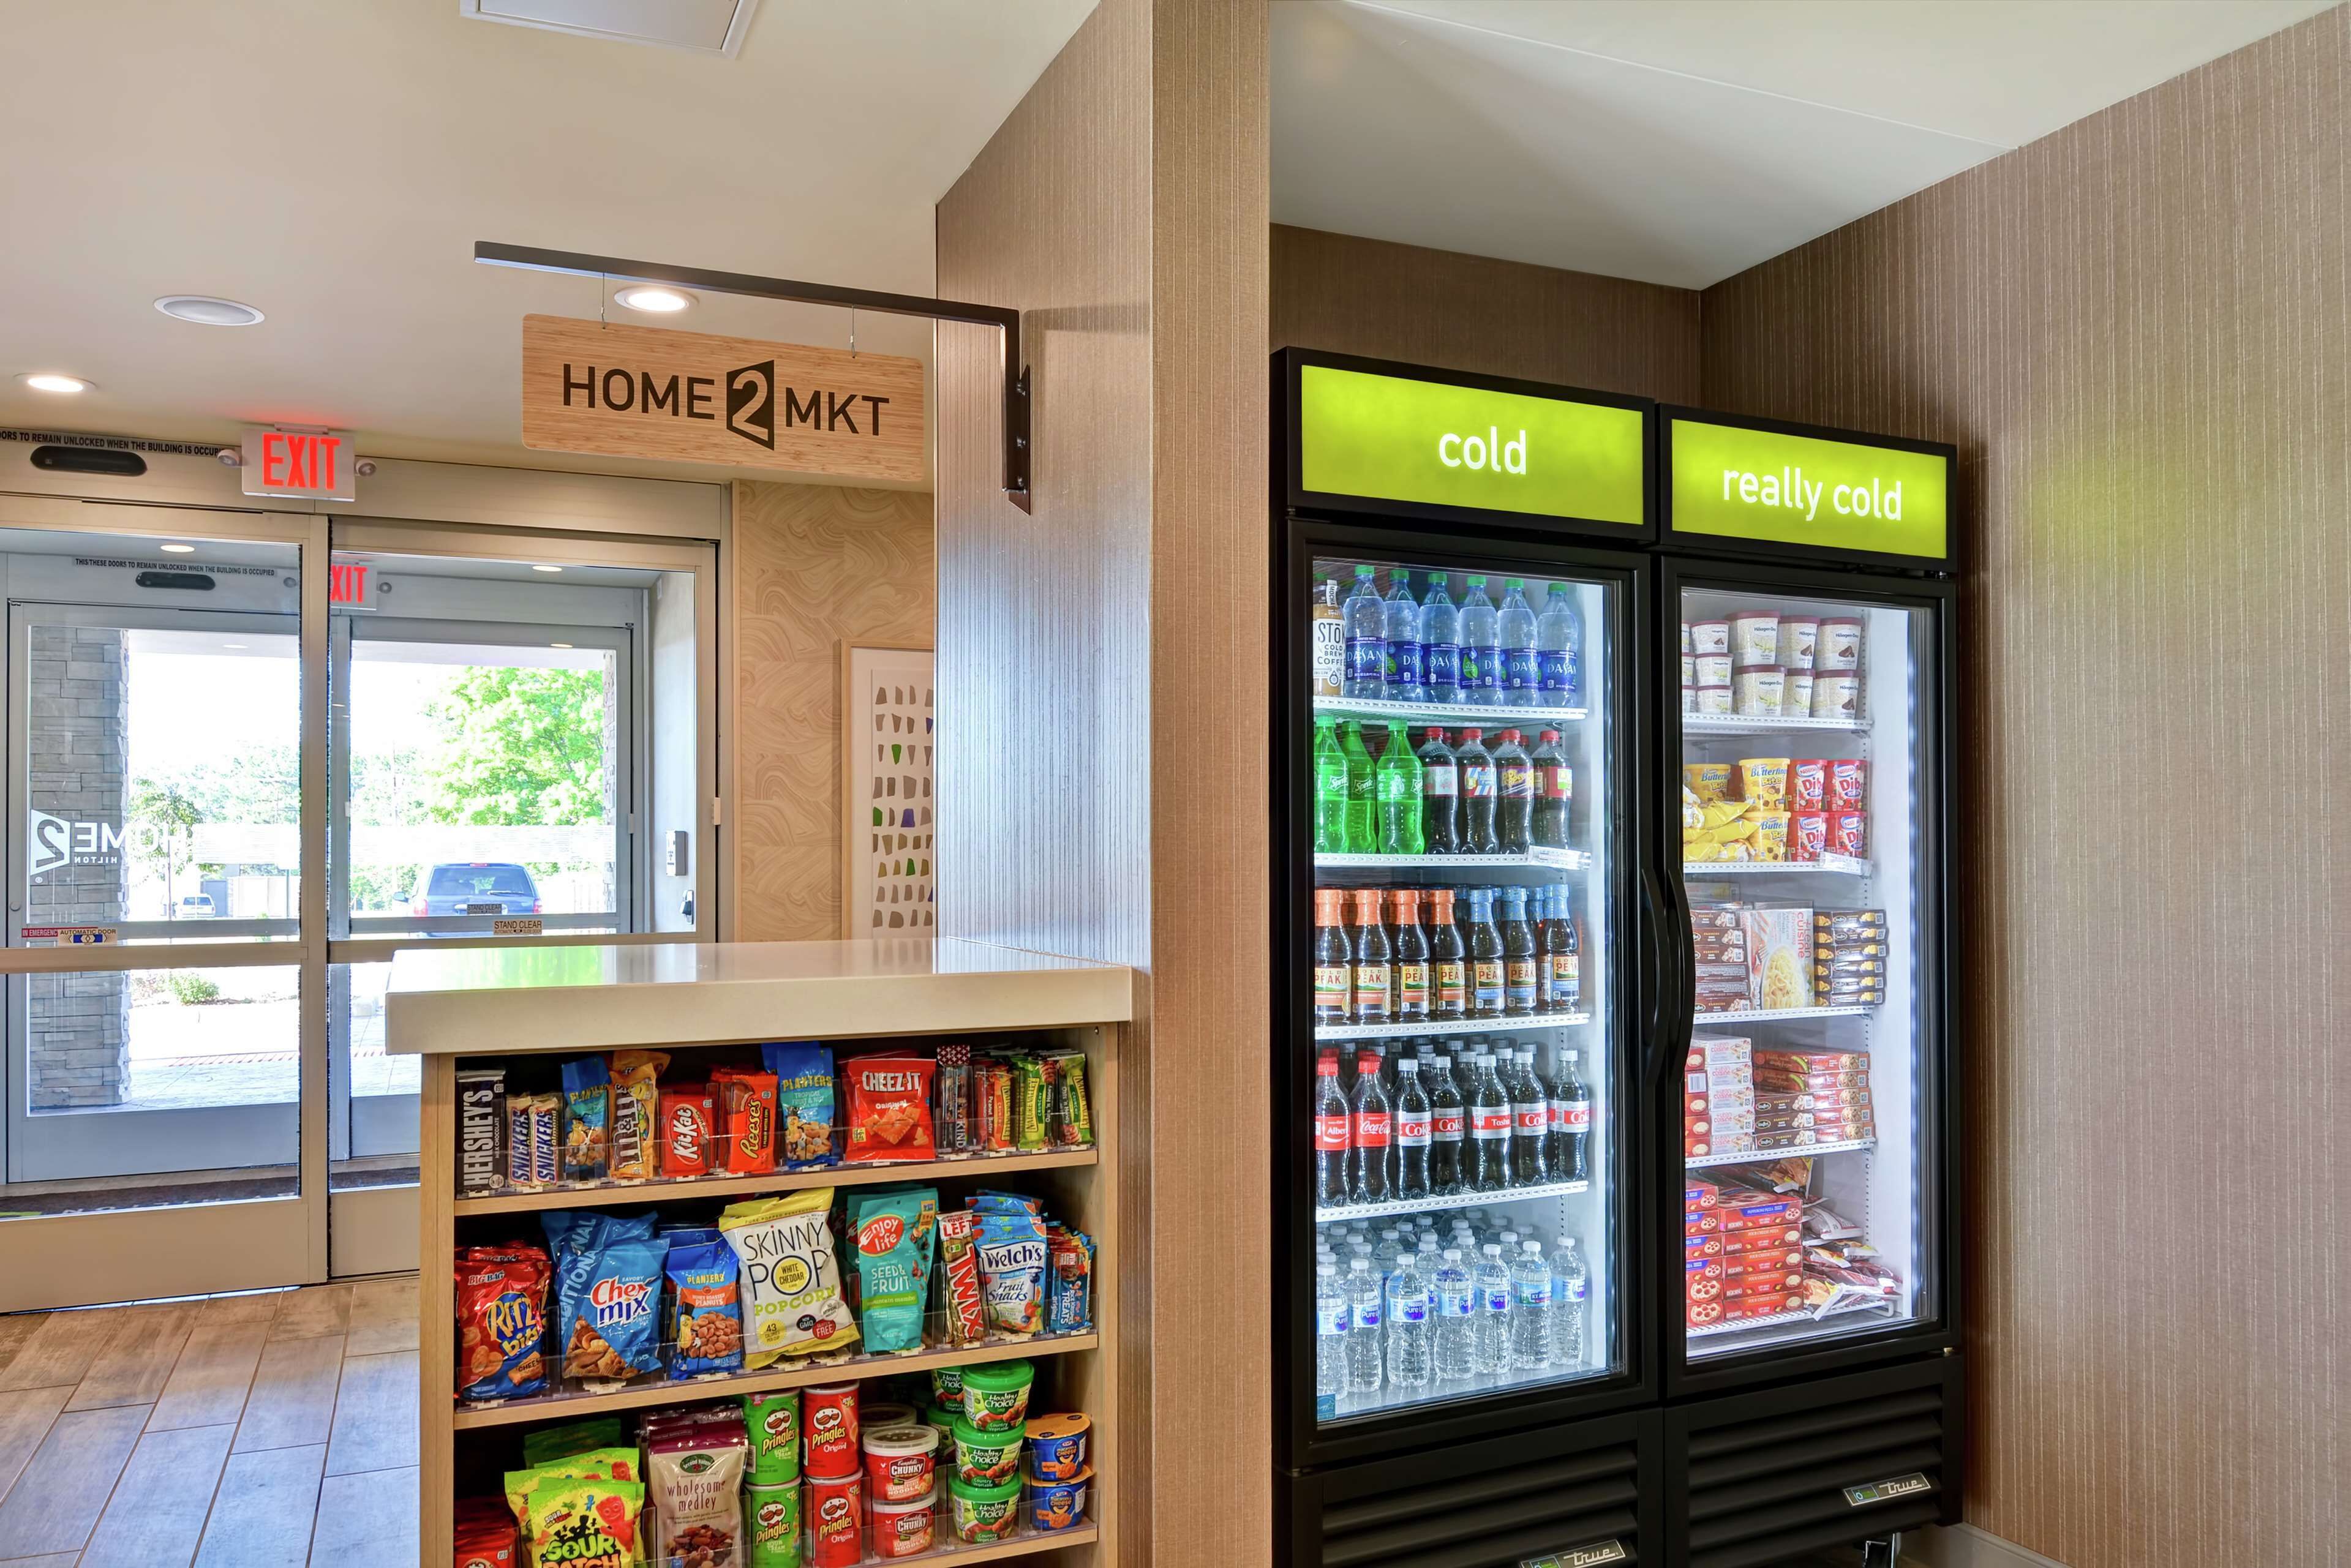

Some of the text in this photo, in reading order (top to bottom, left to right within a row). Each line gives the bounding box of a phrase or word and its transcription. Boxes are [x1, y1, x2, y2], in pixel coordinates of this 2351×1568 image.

[563, 363, 715, 420] HOME
[786, 387, 889, 436] MKT
[20, 432, 192, 454] TO REMAIN UNLOCKED WHEN THE BUILDING IS
[1438, 426, 1527, 476] cold
[262, 432, 341, 490] EXIT
[1722, 466, 1902, 522] really cold
[137, 561, 157, 570] REMAIN
[158, 562, 187, 571] UNLOCKED
[494, 920, 542, 929] STAND CLEAR
[783, 1075, 832, 1092] PLANTERS
[463, 1090, 494, 1187] HERSHEY'S
[956, 1120, 966, 1148] KIND
[536, 1110, 556, 1182] SNICKERS
[743, 1221, 824, 1261] SKINNY
[875, 1232, 897, 1251] life
[985, 1245, 1042, 1268] Welch's
[468, 1270, 505, 1285] BIG BAG
[748, 1250, 829, 1301] POP
[779, 1272, 805, 1285] CHEDDAR
[781, 1263, 799, 1275] WHITE
[871, 1266, 898, 1280] SEED
[686, 1273, 724, 1285] PLANTERS
[871, 1277, 909, 1296] FRUIT
[997, 1281, 1025, 1293] Fruit
[949, 1242, 984, 1338] TWIX
[988, 1289, 1028, 1301] Snacks
[754, 1284, 836, 1316] POPCORN
[1060, 1291, 1069, 1324] TREATS
[491, 1297, 537, 1340] RITZ
[766, 1323, 777, 1332] 43
[816, 1324, 833, 1337] FREE
[502, 1326, 540, 1356] bits
[984, 1399, 1014, 1408] Choice
[988, 1393, 1017, 1401] Healthy
[761, 1428, 795, 1456] Pringles
[812, 1426, 846, 1450] Pringles
[969, 1454, 999, 1464] Choice
[973, 1449, 1002, 1458] Healthy
[891, 1463, 923, 1476] CHUNKY
[679, 1493, 717, 1512] medley
[545, 1510, 562, 1523] SOUR
[974, 1508, 1004, 1517] Choice
[819, 1515, 852, 1542] Pringles
[897, 1517, 927, 1532] CHUNKY
[756, 1521, 790, 1548] Pringles
[546, 1533, 615, 1561] SOUR
[1563, 1548, 1616, 1567] true
